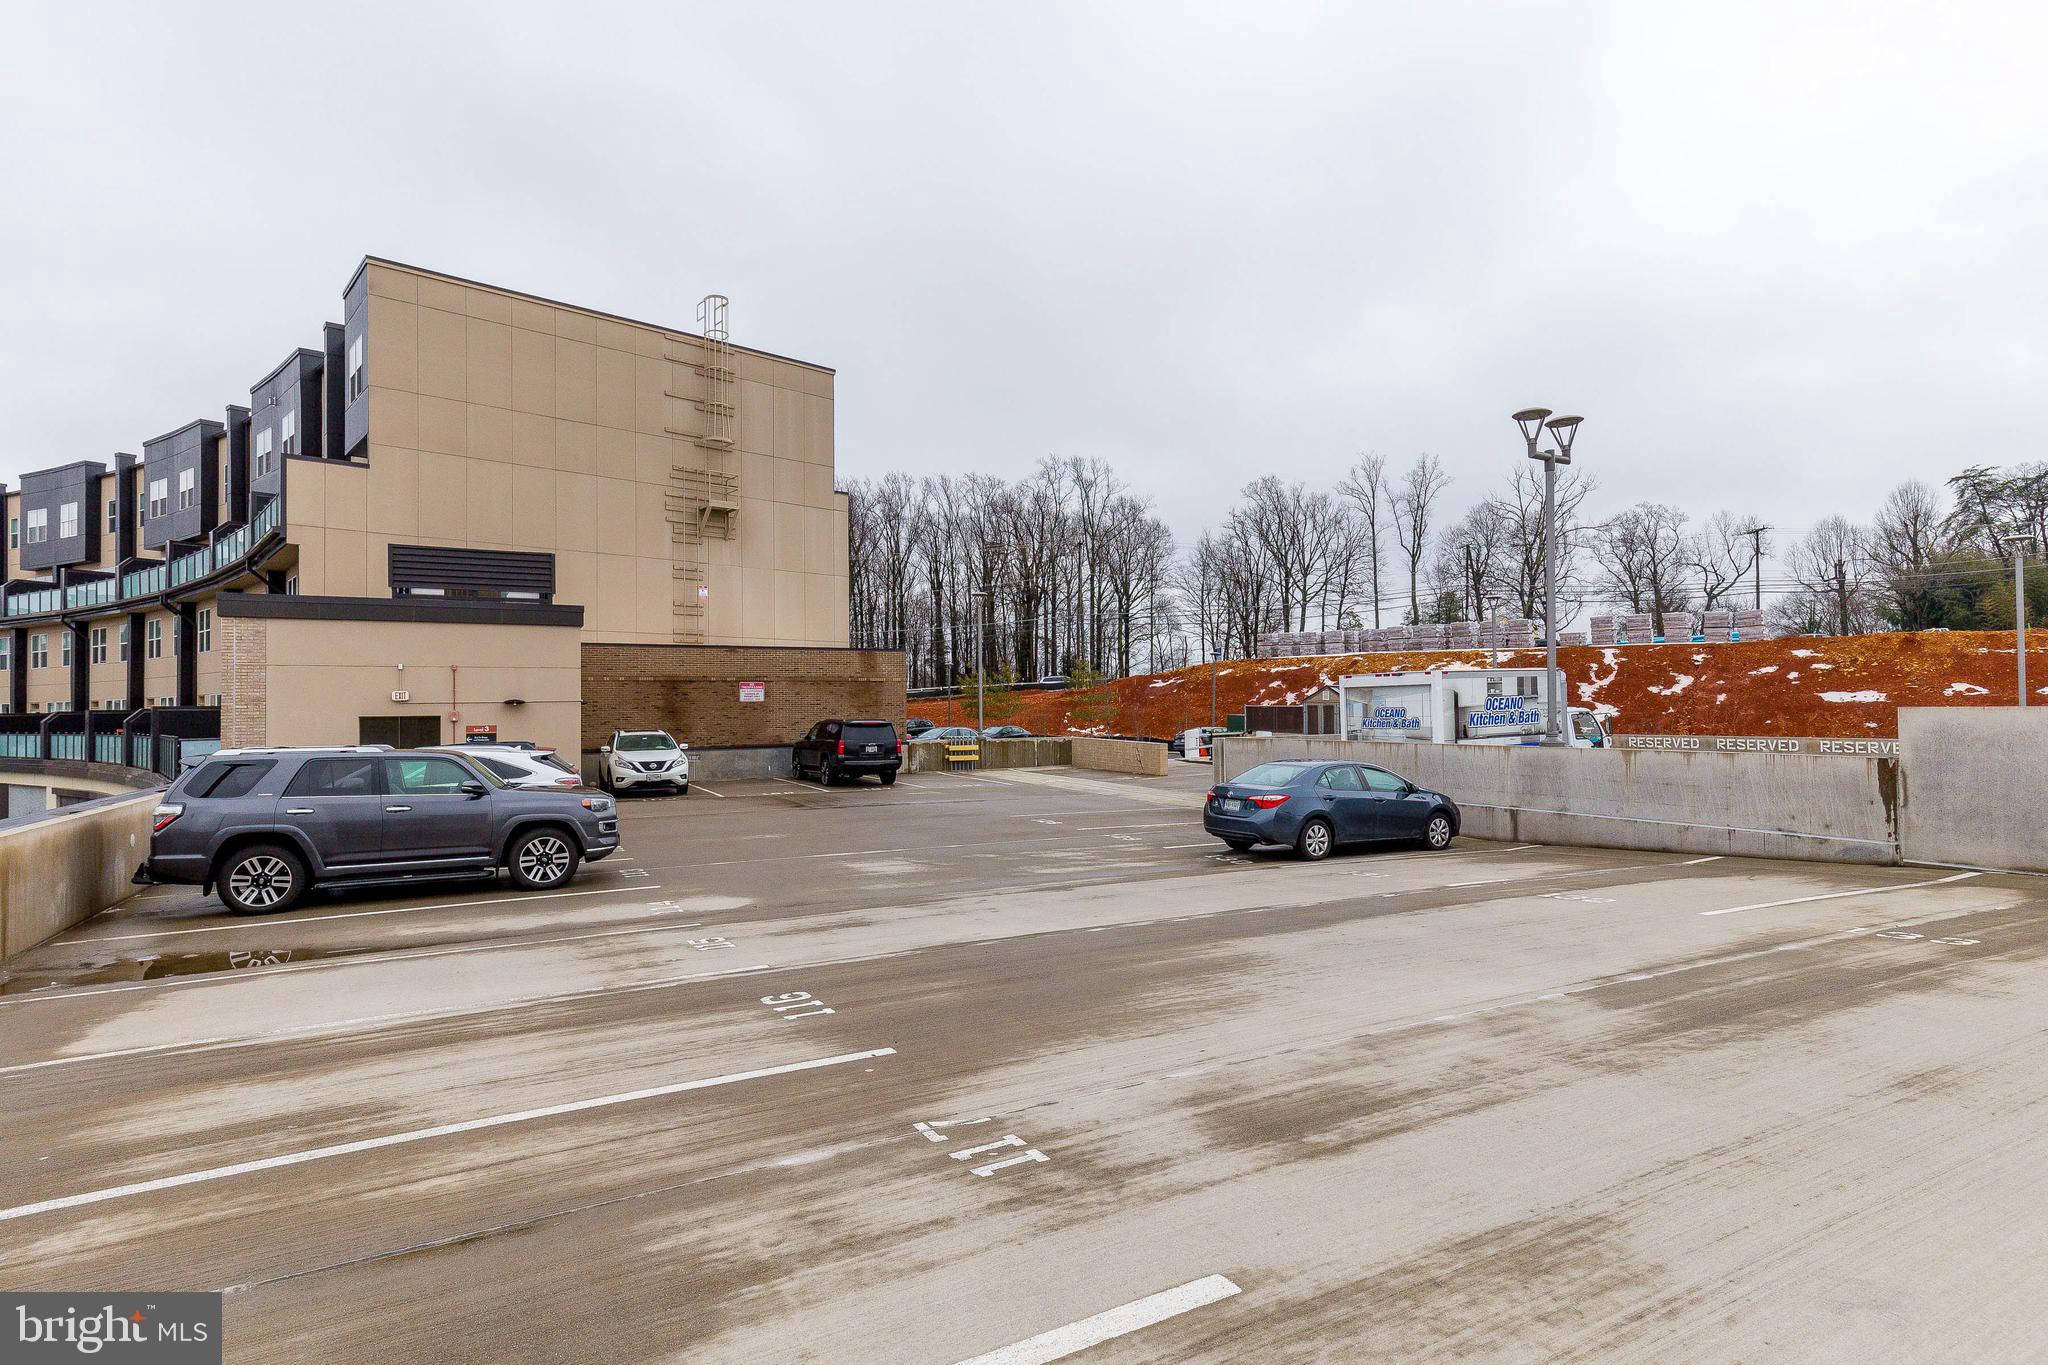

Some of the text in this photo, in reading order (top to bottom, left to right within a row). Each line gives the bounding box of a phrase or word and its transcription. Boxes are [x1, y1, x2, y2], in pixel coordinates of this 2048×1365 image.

[394, 692, 407, 700] EXIT
[1485, 696, 1524, 711] OCEANO
[1374, 707, 1406, 718] OCEANO
[1468, 709, 1540, 727] Kitchen & Bath
[1362, 718, 1421, 729] Kitchen & Bath
[1628, 737, 1700, 749] RESERVED
[1716, 738, 1799, 752] RESERVED
[1820, 741, 1900, 755] RESERVE
[760, 991, 836, 1021] 116
[912, 1116, 1051, 1178] 117
